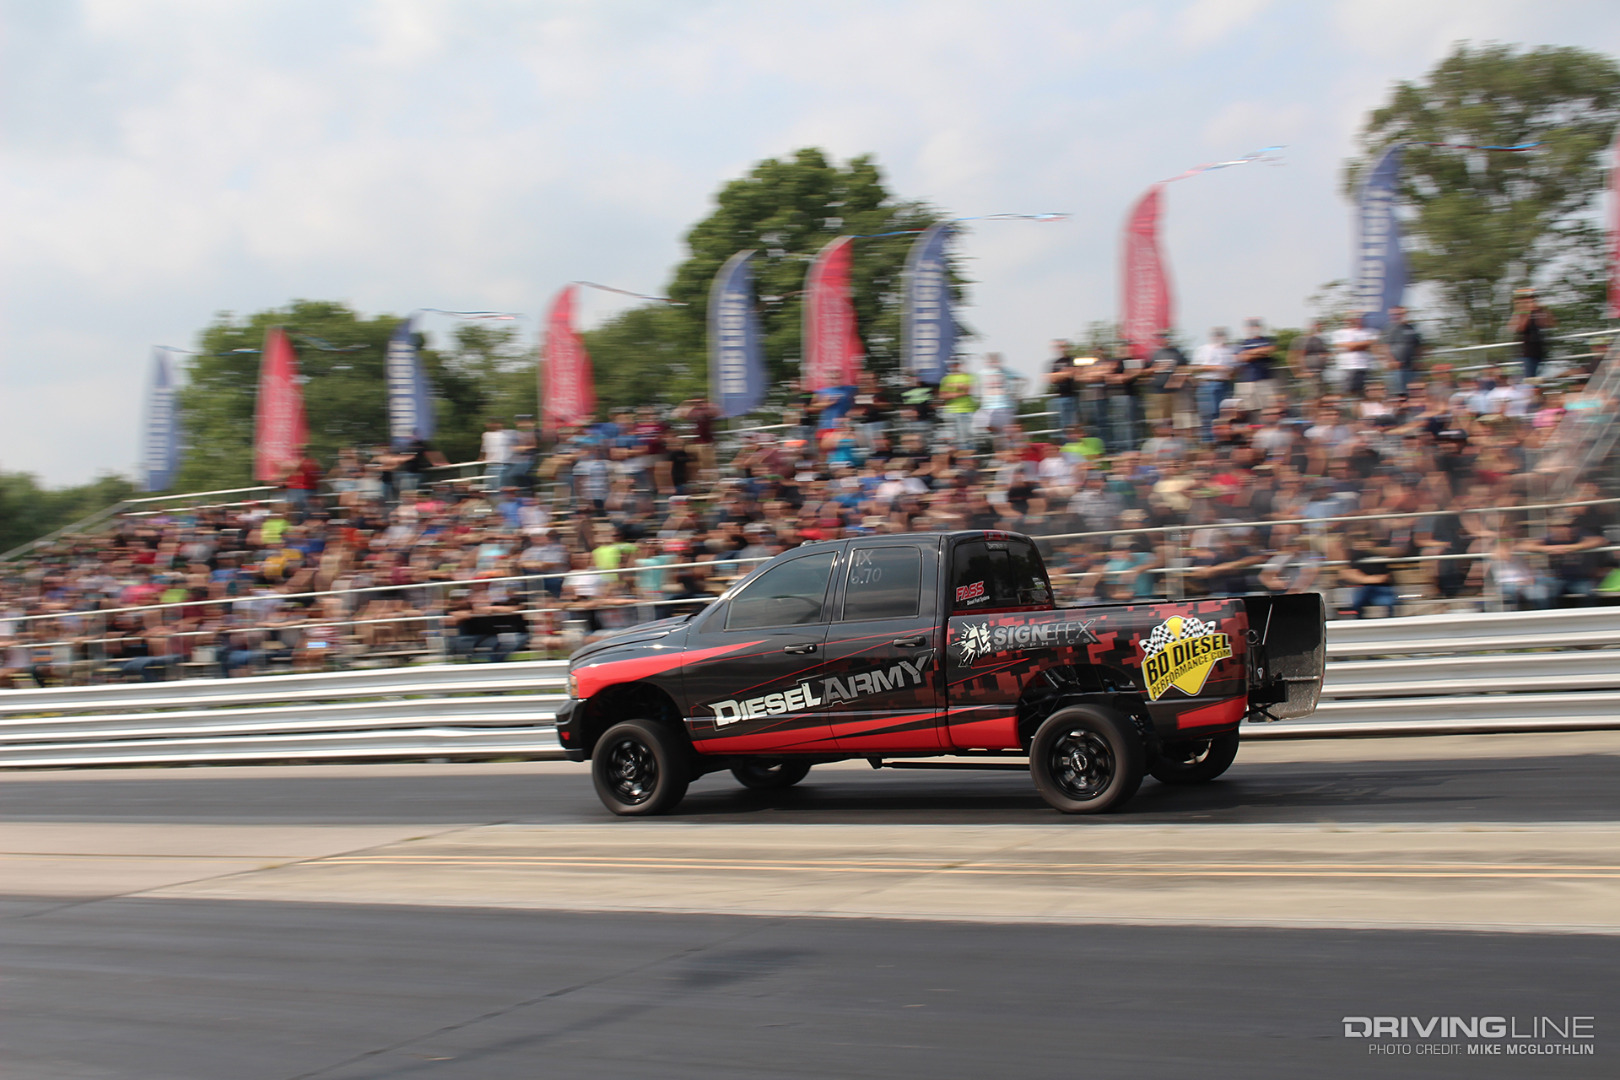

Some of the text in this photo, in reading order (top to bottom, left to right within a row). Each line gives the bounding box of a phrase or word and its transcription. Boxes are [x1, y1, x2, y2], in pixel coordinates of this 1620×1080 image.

[955, 580, 984, 603] FASS
[994, 638, 1091, 651] GRAPHICS
[1146, 634, 1231, 686] BD DIESEL
